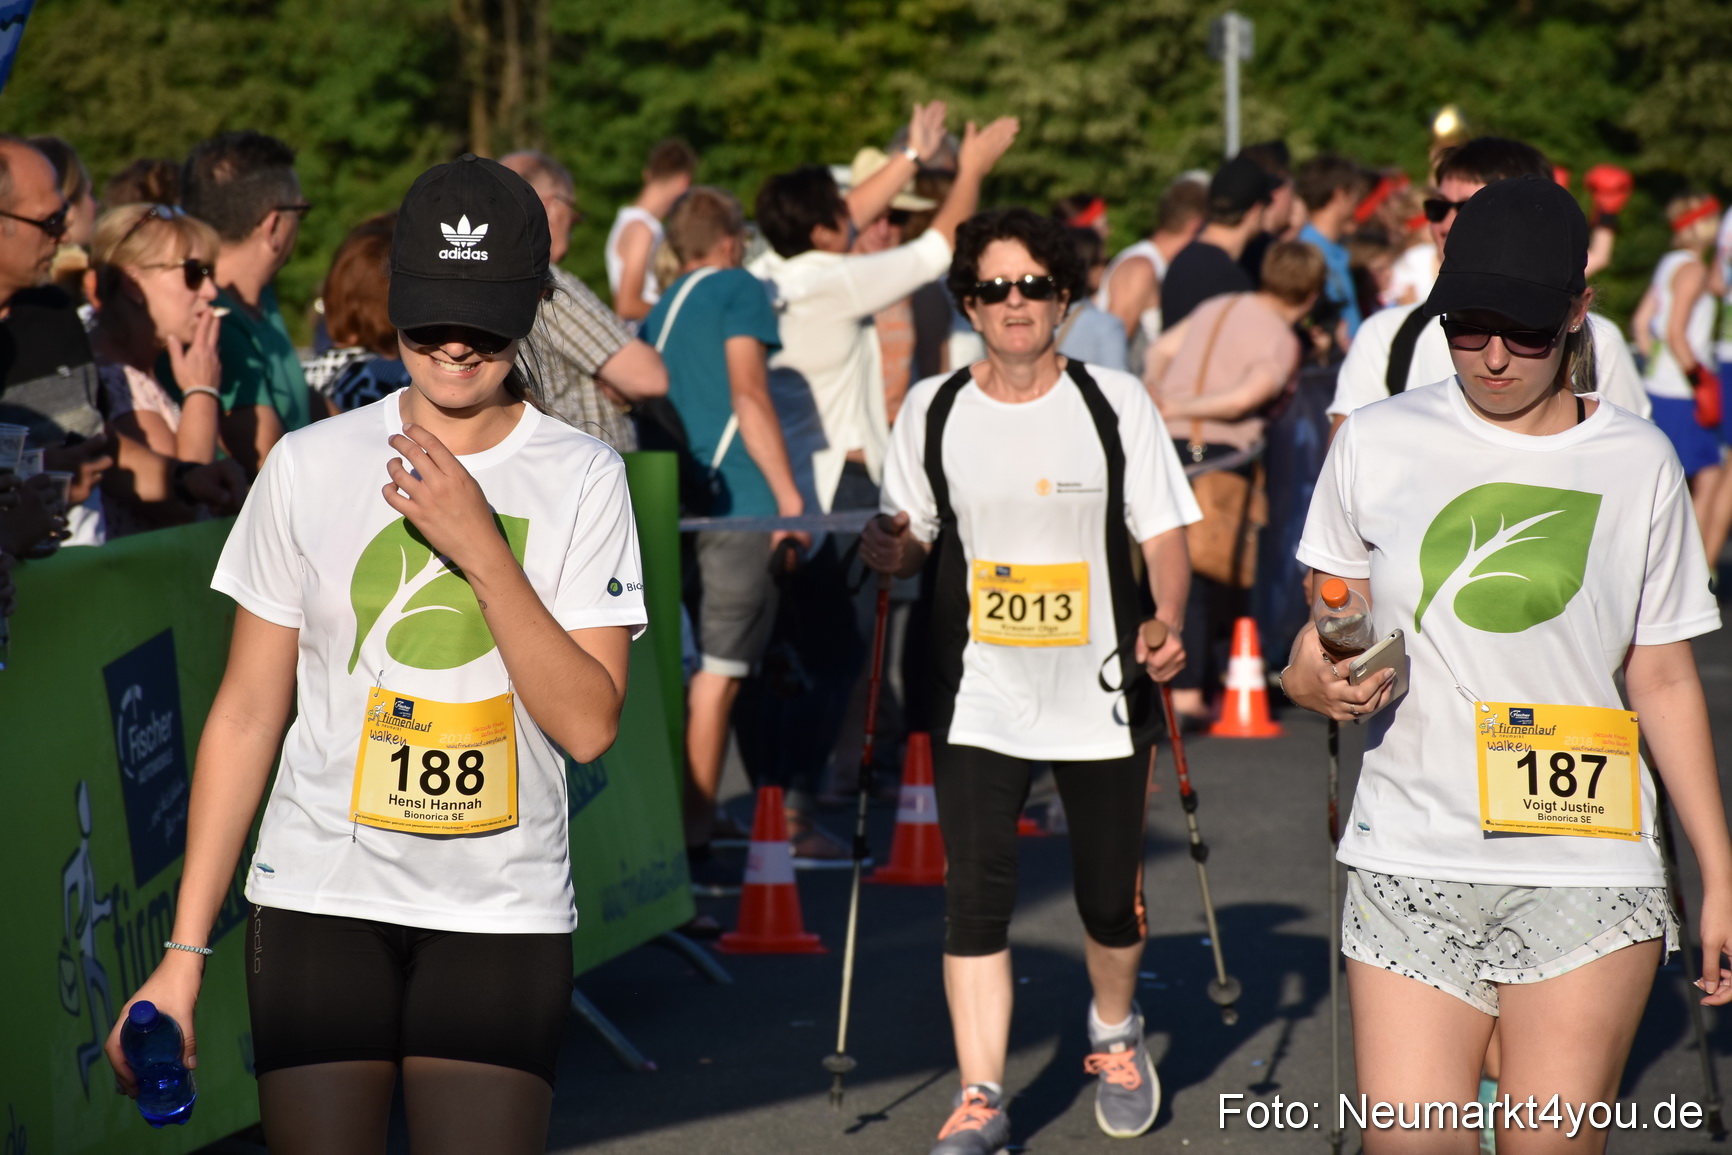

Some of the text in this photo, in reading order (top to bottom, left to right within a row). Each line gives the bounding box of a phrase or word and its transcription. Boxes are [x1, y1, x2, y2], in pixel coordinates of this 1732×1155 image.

[439, 247, 488, 260] adidas
[626, 582, 644, 592] Bio
[987, 591, 1072, 622] 2013
[383, 712, 433, 732] firmenlauf
[1499, 723, 1557, 736] firmenlauf
[128, 710, 174, 765] Fischer
[370, 729, 407, 746] walken
[439, 733, 471, 744] 2018
[1564, 735, 1593, 746] 2018
[1487, 740, 1532, 752] walken
[391, 745, 484, 796] 188
[1518, 751, 1607, 799] 187
[389, 793, 482, 810] Hensl Hannah
[1523, 799, 1605, 814] Voigt Justine
[404, 810, 464, 821] Bionorica SE
[1538, 813, 1592, 824] Bionorica SE
